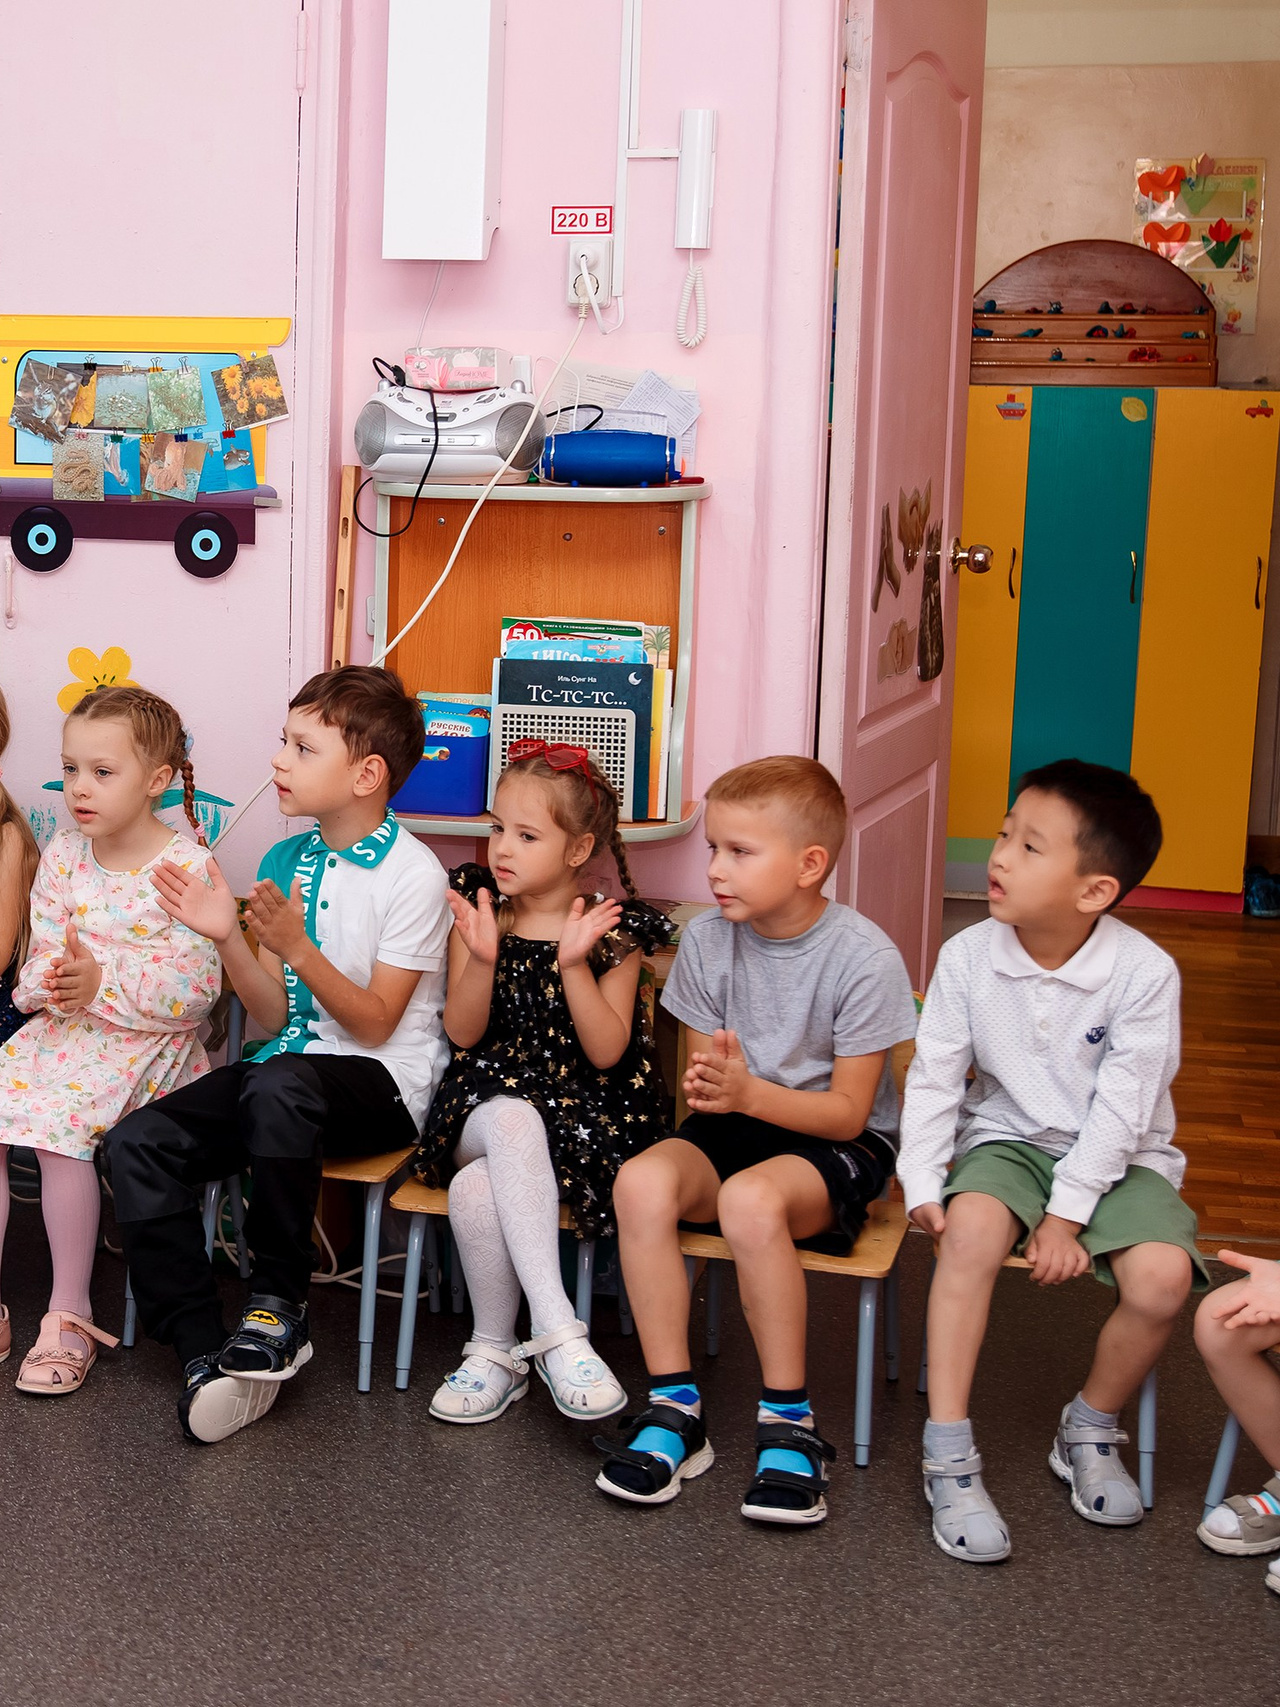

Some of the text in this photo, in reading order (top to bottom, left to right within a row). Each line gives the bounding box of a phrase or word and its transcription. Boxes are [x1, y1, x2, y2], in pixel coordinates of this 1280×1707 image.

[557, 212, 607, 227] 220 В
[512, 628, 539, 641] 50
[430, 721, 471, 733] РУССКИЕ
